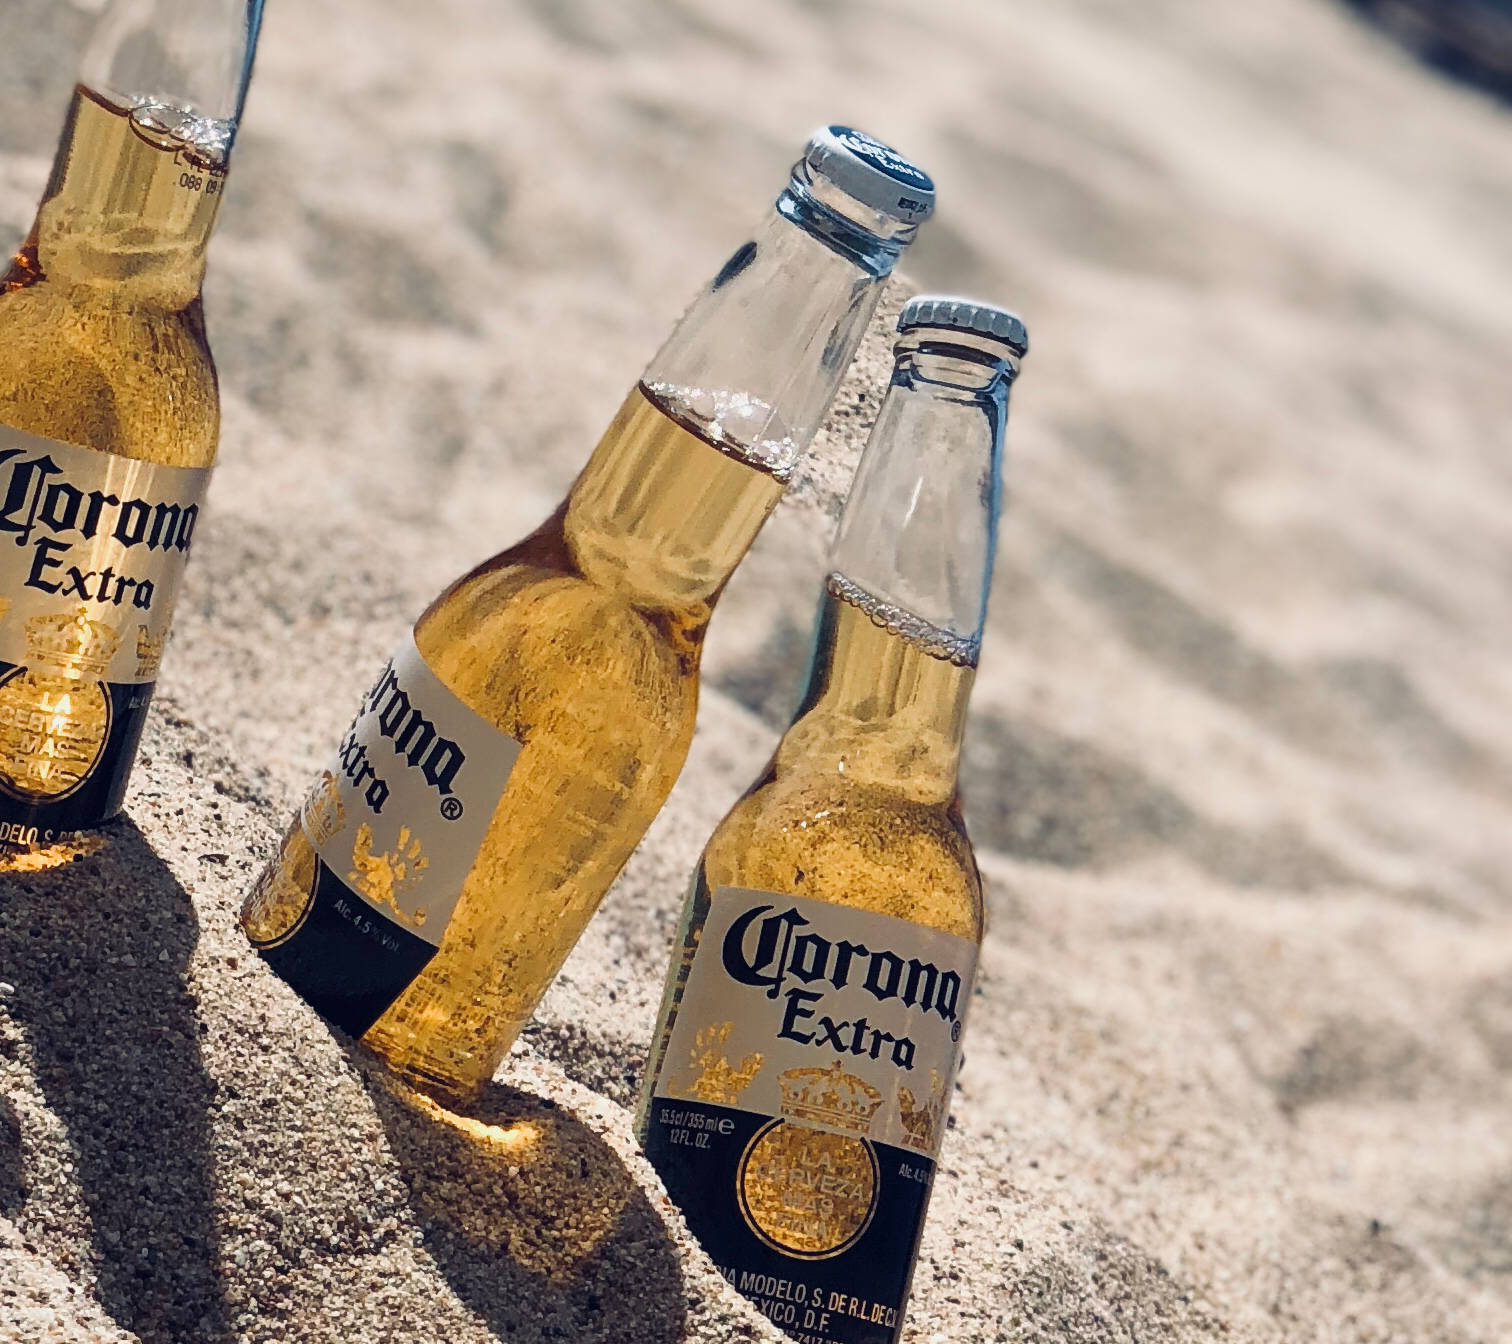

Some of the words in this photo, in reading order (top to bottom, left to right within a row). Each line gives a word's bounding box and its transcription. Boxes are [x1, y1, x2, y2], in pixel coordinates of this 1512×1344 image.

[24, 536, 155, 610] Extra
[40, 691, 71, 715] LA
[361, 657, 465, 795] rona
[339, 722, 390, 814] xtra
[722, 905, 961, 1023] Corona
[777, 987, 916, 1071] Extra
[740, 1271, 808, 1307] MODELO,
[811, 1287, 825, 1309] S.
[828, 1292, 847, 1314] DE
